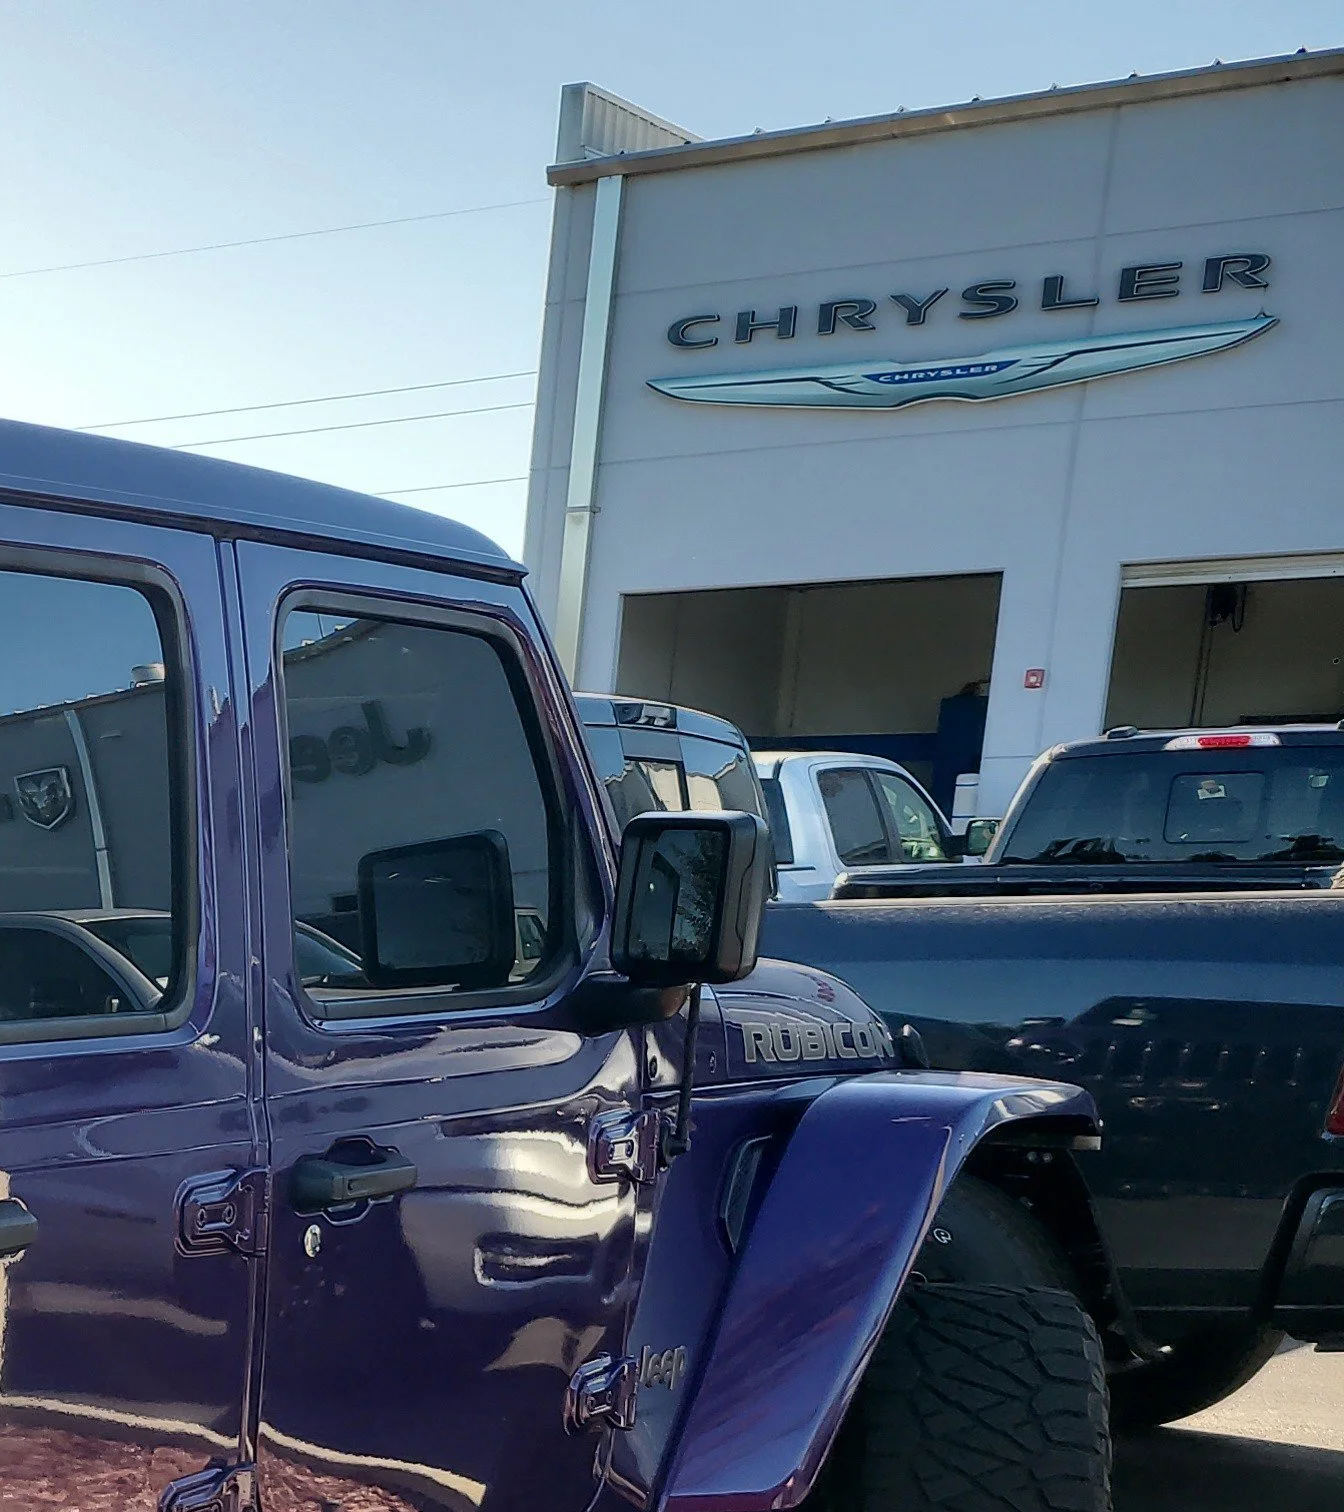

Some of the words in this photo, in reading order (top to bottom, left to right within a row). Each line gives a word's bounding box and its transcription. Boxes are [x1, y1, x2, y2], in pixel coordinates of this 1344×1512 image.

[666, 252, 1272, 350] CHRYSLER
[878, 363, 999, 382] CHRYSLER
[742, 1021, 895, 1063] RUBICON
[639, 1345, 686, 1391] Jeep
